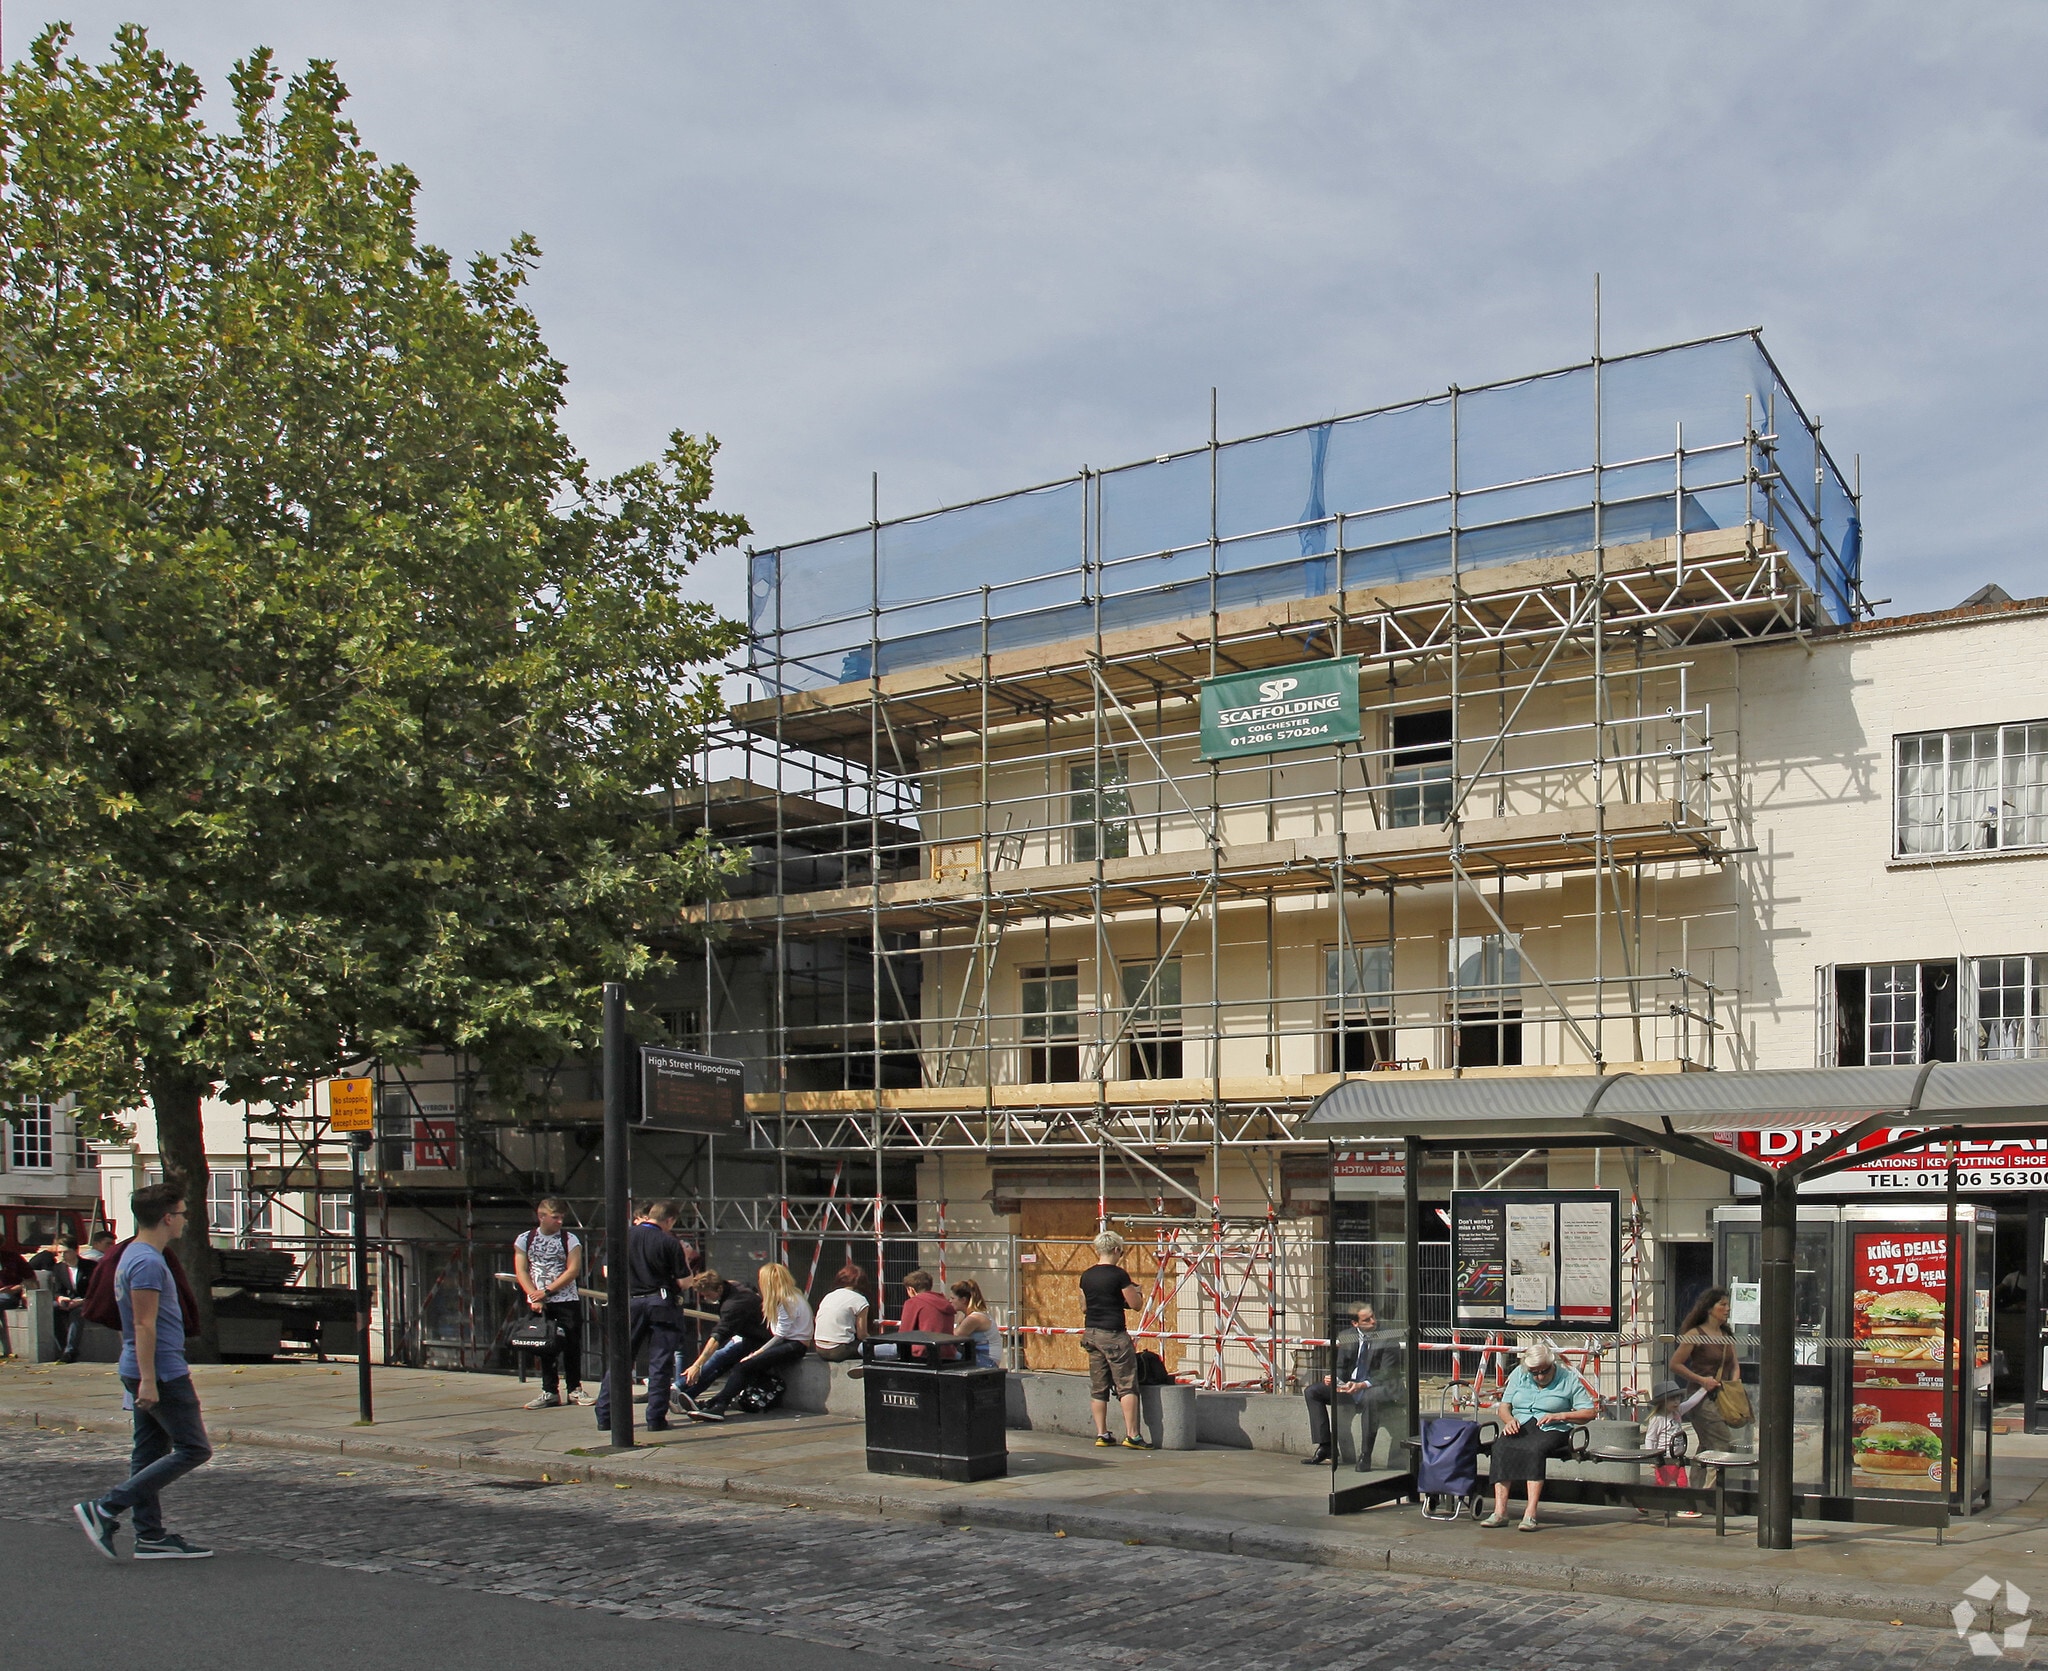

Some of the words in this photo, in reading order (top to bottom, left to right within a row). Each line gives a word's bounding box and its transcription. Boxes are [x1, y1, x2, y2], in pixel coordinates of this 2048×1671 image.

[1259, 678, 1298, 703] SP
[1220, 696, 1339, 725] SCAFFOLDING
[1247, 718, 1310, 733] COLCHESTER
[1230, 732, 1273, 746] 01206
[1276, 724, 1329, 740] 570204
[648, 1056, 668, 1068] High
[669, 1058, 693, 1071] Street
[694, 1062, 741, 1076] Hippodrome
[343, 1095, 368, 1105] stopping
[343, 1109, 353, 1117] any
[333, 1120, 352, 1128] except
[425, 1145, 450, 1160] LET
[1852, 1159, 1918, 1169] ERATIONS
[1926, 1158, 1948, 1167] KEY
[2013, 1155, 2047, 1166] SHOE
[1867, 1174, 1909, 1188] TEL:
[1867, 1243, 1901, 1260] KING
[1903, 1239, 1947, 1257] DEALS
[1868, 1262, 1919, 1286] £3.79
[512, 1339, 547, 1347] Slazenger
[883, 1394, 917, 1406] LITTER
